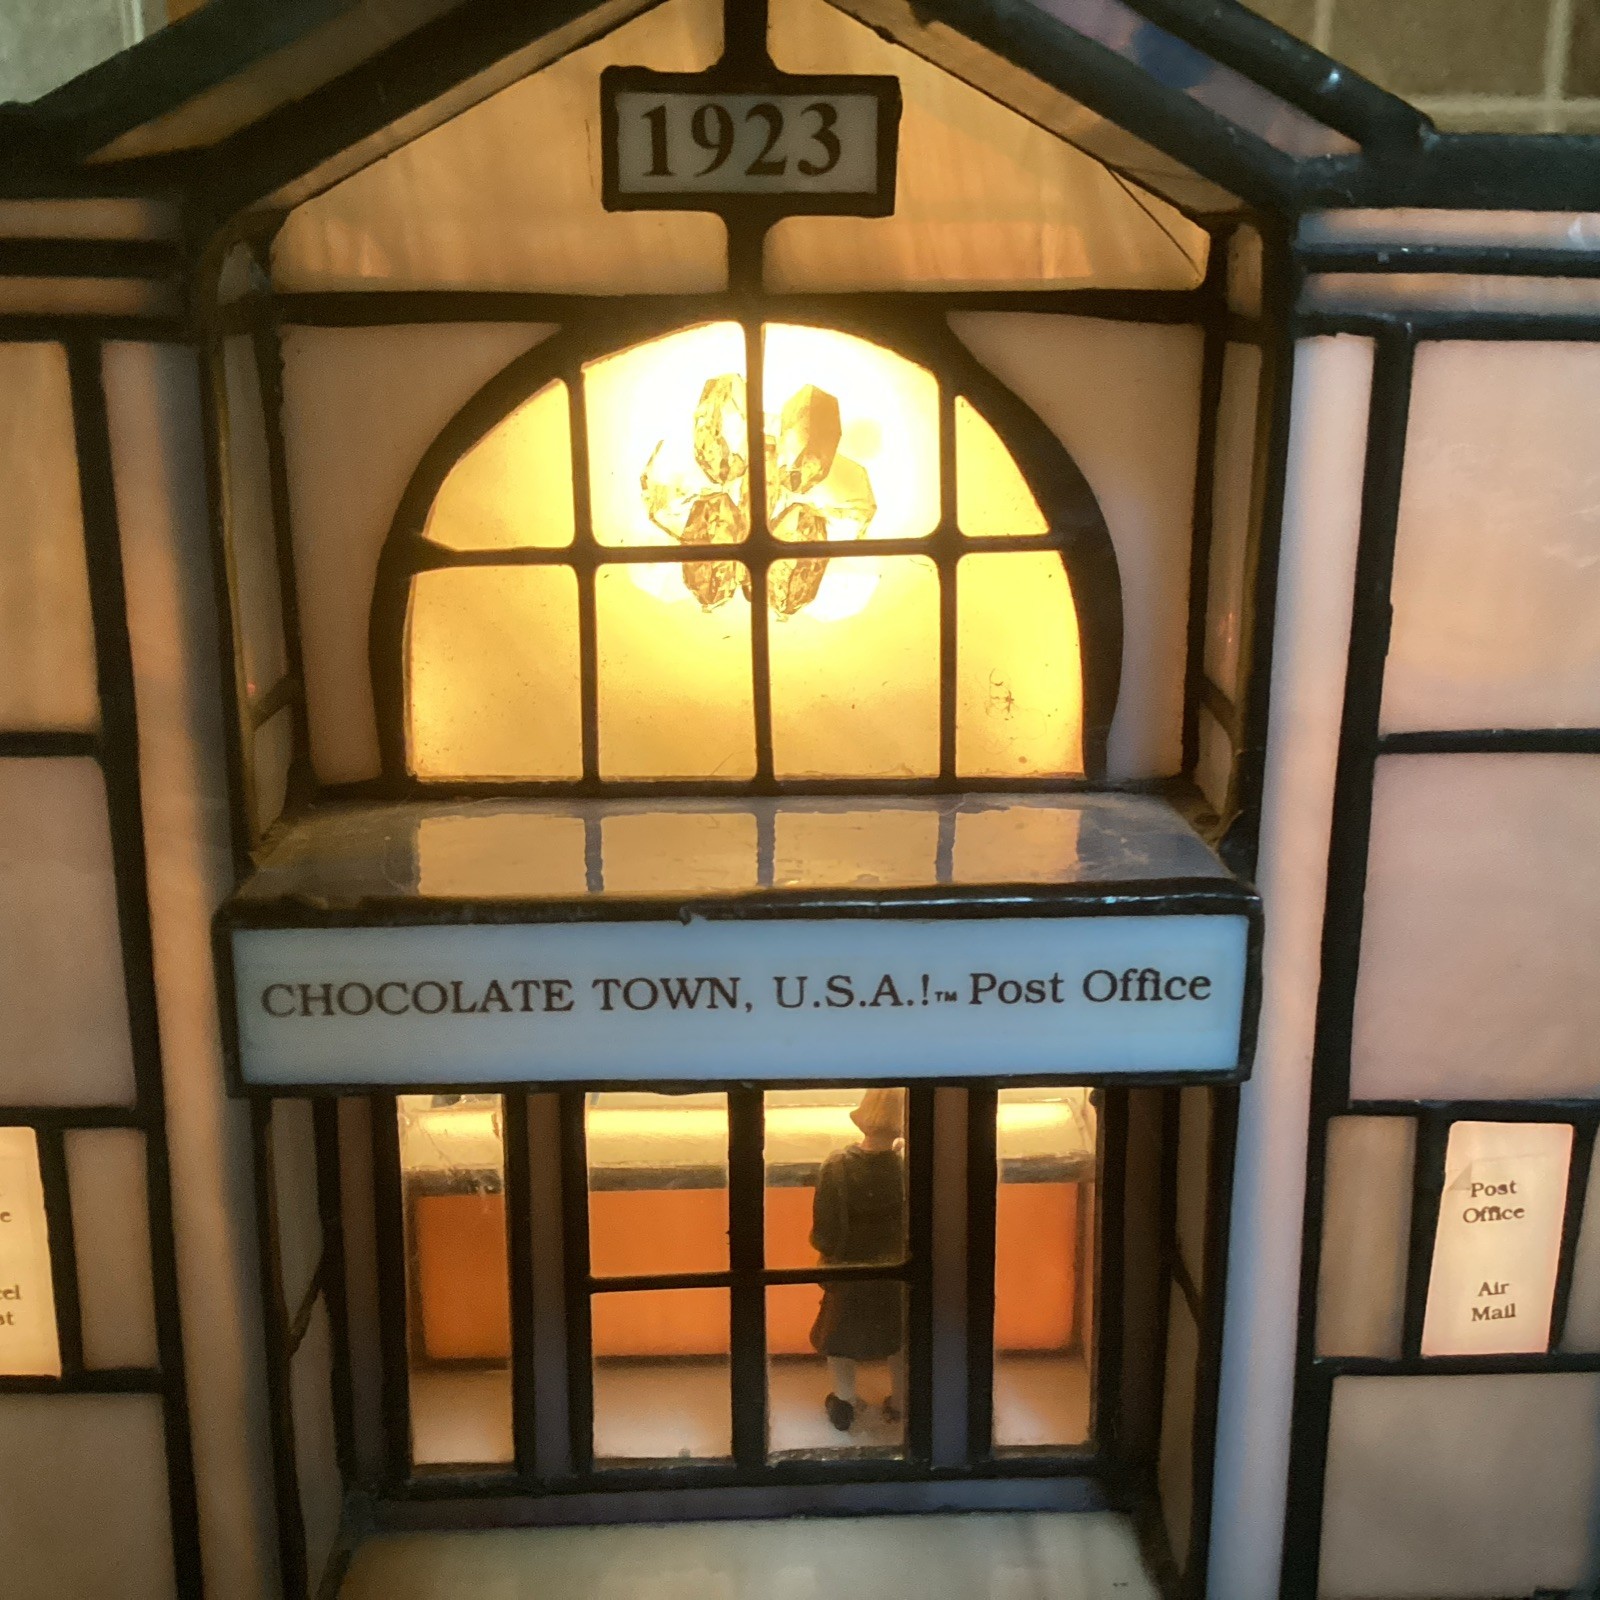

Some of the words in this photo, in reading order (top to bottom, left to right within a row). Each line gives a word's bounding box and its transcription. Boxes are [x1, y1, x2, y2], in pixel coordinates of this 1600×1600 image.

[641, 102, 842, 178] 1923
[260, 978, 576, 1019] CHOCOLATE
[592, 976, 754, 1014] TOWN,
[969, 972, 1065, 1006] Post
[1082, 967, 1213, 1003] Office
[1470, 1179, 1518, 1198] Post
[1463, 1205, 1525, 1224] Office
[1478, 1281, 1510, 1298] Air
[1471, 1303, 1517, 1323] Mail
